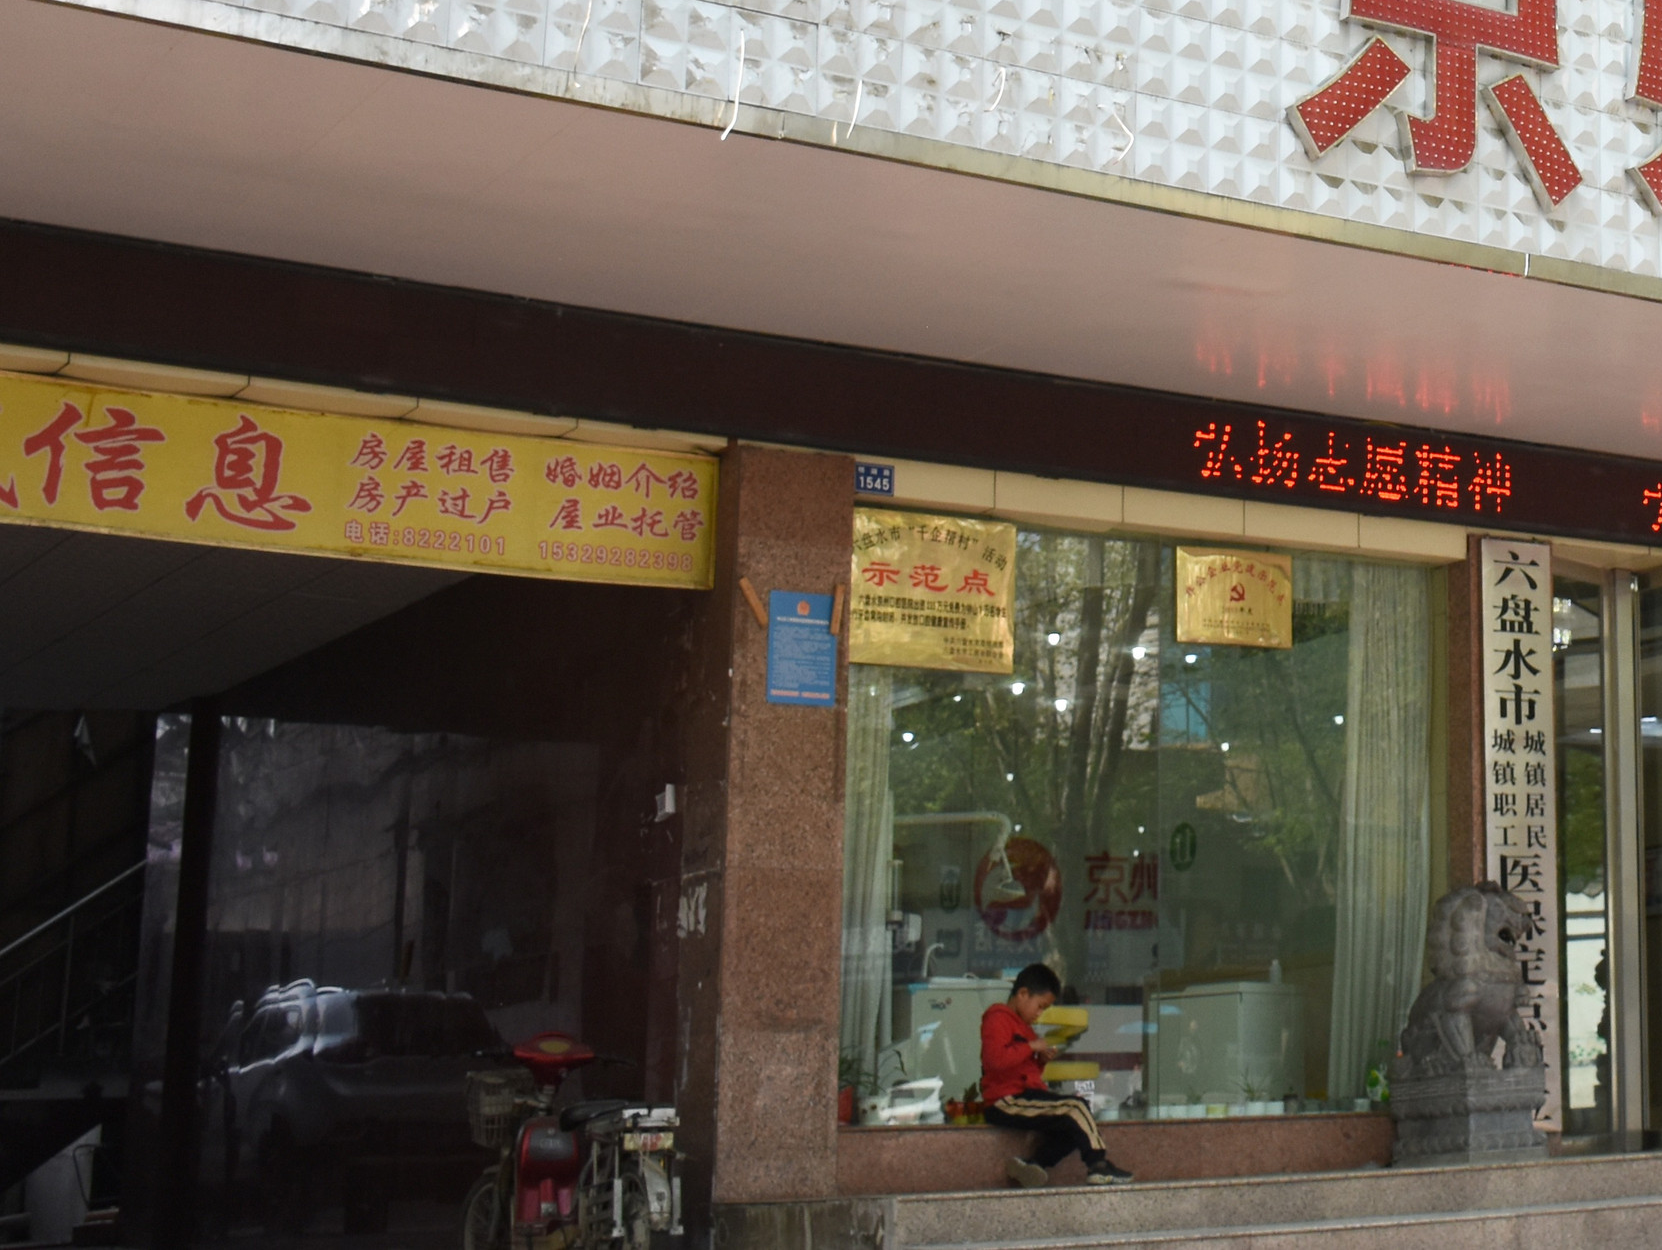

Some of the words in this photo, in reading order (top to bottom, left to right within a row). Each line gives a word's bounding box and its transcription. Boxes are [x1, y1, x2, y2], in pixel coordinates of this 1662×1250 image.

[0, 401, 312, 531] 信息
[351, 432, 515, 485] 房屋租售
[545, 456, 701, 501] 婚姻介绍
[858, 476, 891, 492] 1545
[1194, 421, 1512, 513] 弘扬志愿精神
[344, 519, 506, 555] 电话:8222101
[538, 541, 694, 572] 15329282398
[347, 476, 513, 525] 房产过户
[550, 498, 705, 542] 屋业托管
[861, 561, 996, 597] 示范点
[1492, 551, 1545, 727] 六盘水市
[1491, 728, 1518, 848] 城镇职工
[1523, 730, 1548, 849] 城镇居民
